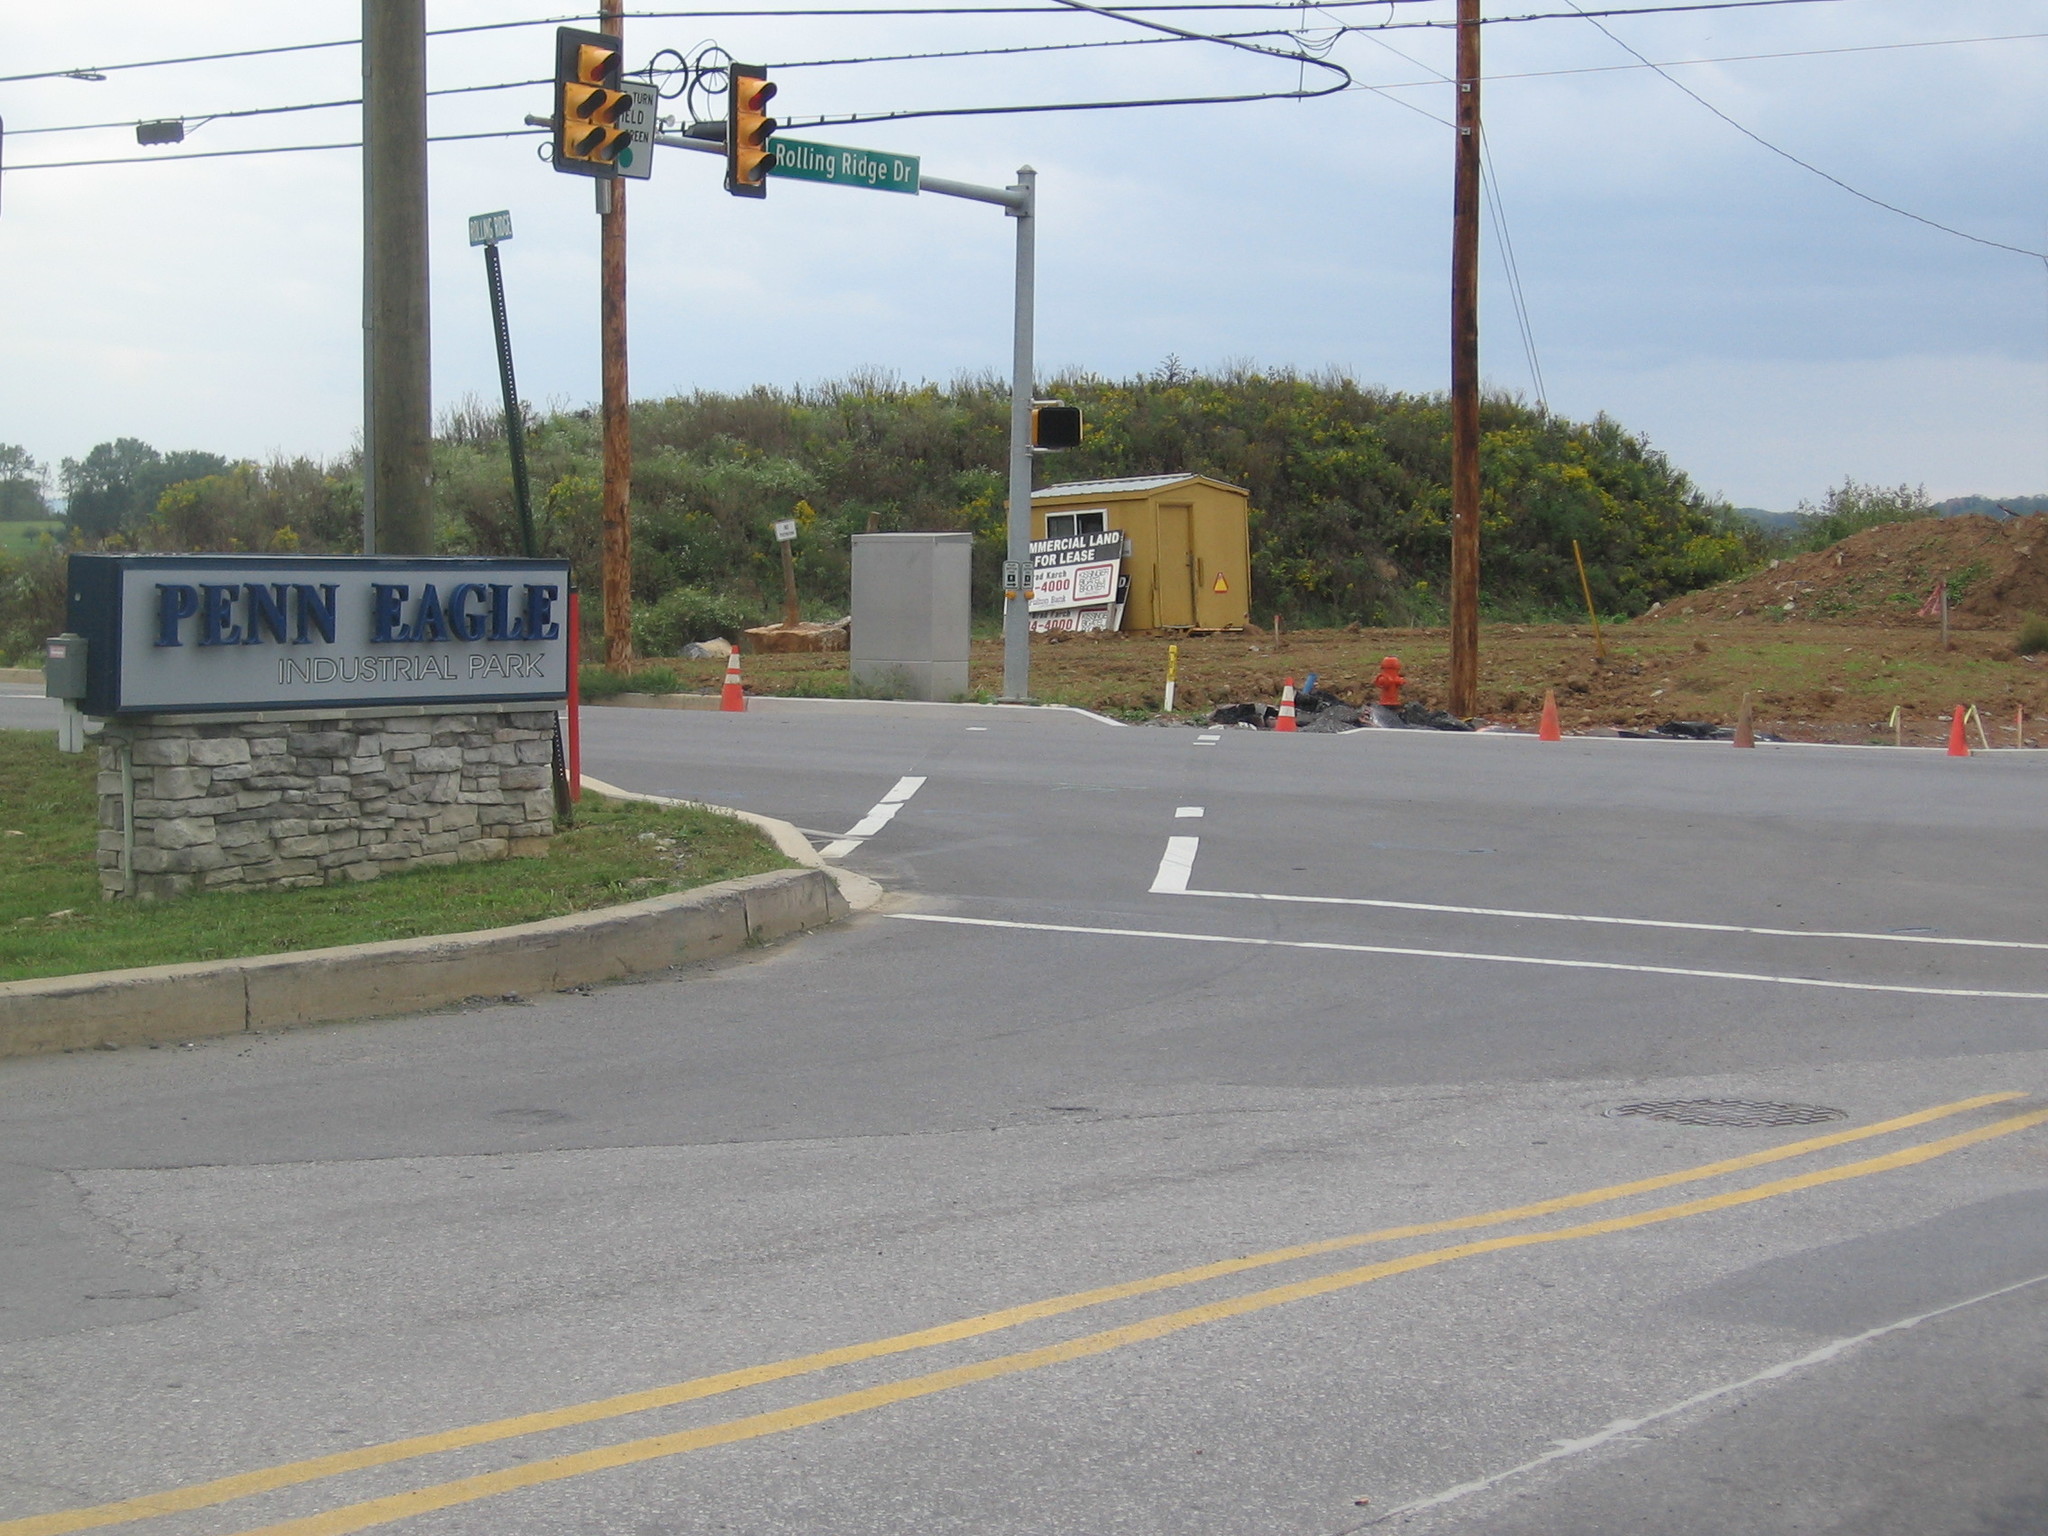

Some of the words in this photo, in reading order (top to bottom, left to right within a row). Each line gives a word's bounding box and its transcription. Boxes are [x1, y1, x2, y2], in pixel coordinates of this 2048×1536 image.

[632, 92, 654, 106] TURN
[620, 109, 644, 125] IELD
[625, 129, 649, 143] REEN
[775, 143, 835, 179] Rolling
[841, 152, 887, 184] Ridge
[893, 159, 912, 183] Dr
[1029, 536, 1087, 554] MMERCIAL
[1089, 531, 1120, 547] LAND
[1034, 553, 1057, 568] FOR
[1059, 549, 1096, 565] LEASE
[153, 582, 341, 647] PENN
[370, 582, 560, 644] EAGLE
[277, 655, 457, 685] INDUSTRIAL
[467, 652, 546, 679] PARK
